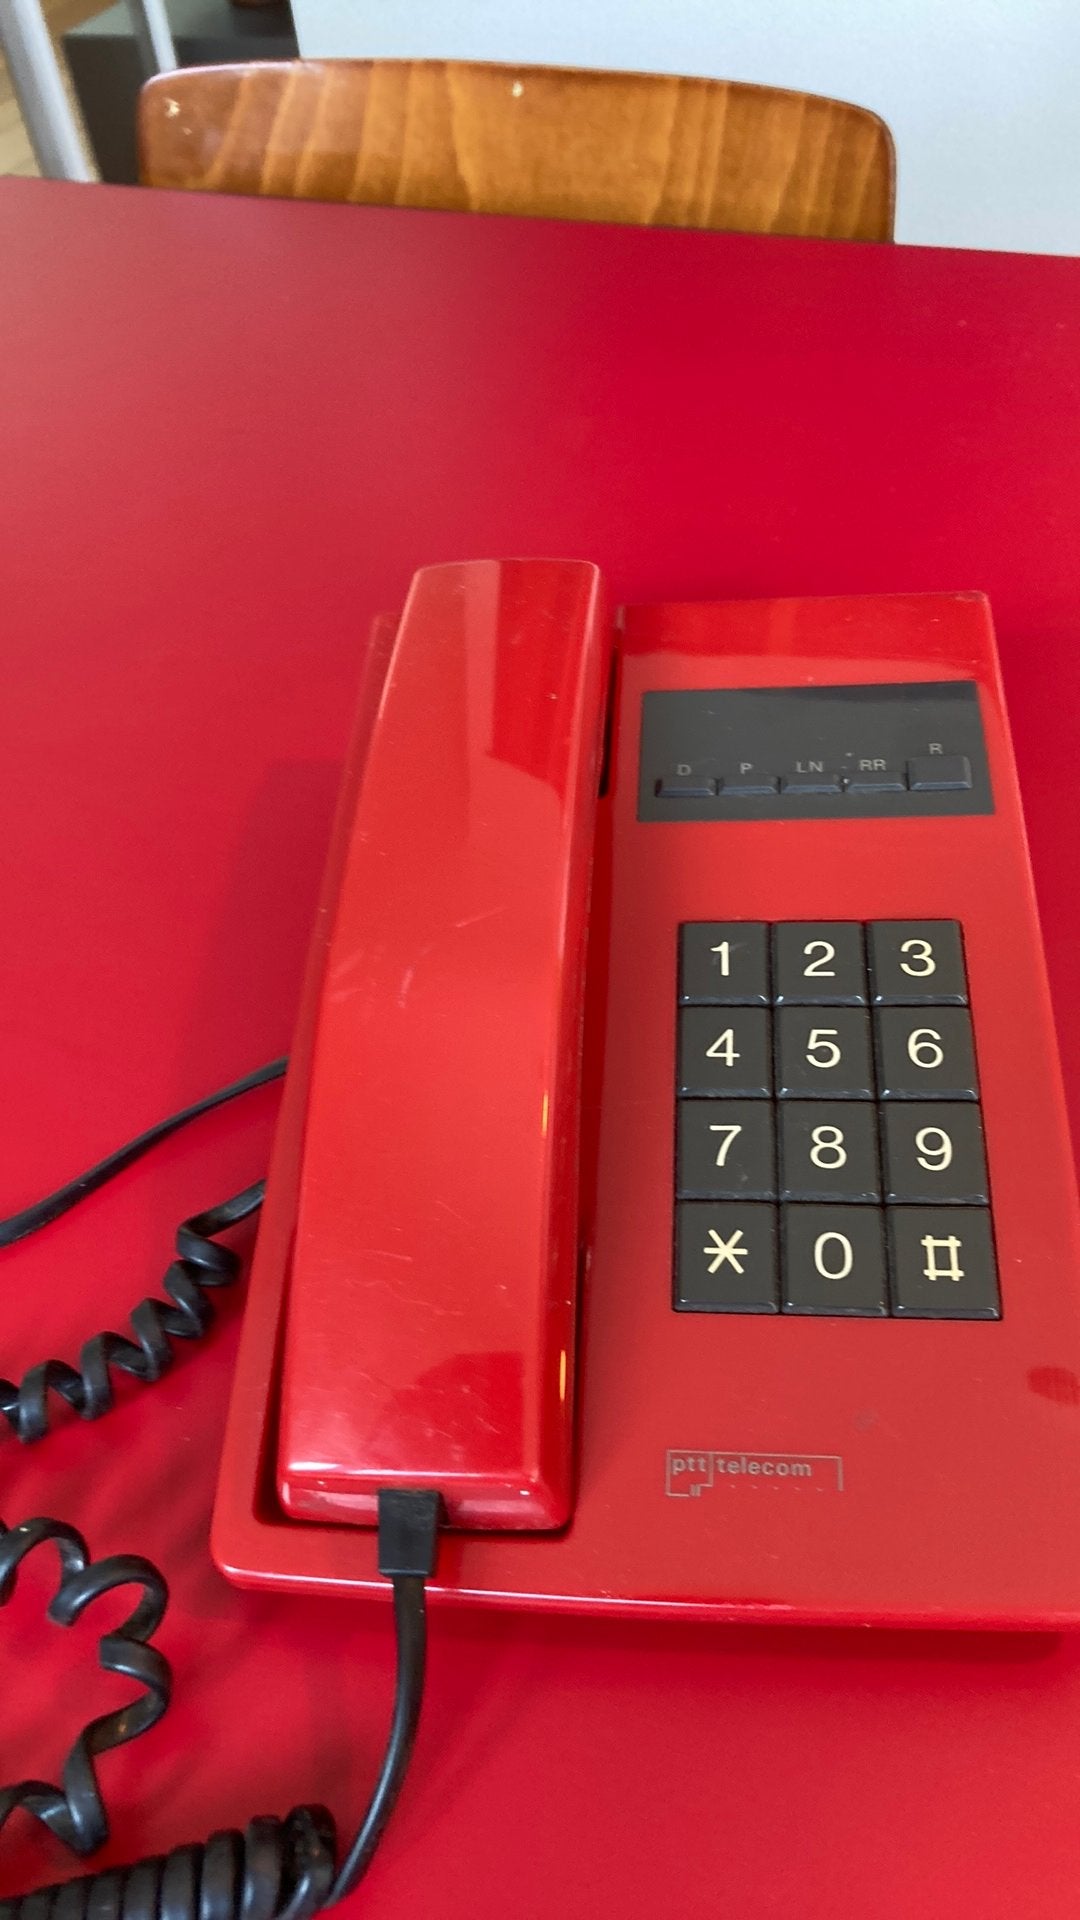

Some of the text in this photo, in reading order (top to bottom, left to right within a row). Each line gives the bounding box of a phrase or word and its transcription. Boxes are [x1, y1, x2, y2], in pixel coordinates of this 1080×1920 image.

[677, 742, 943, 777] D P LN RR R
[710, 939, 936, 977] 1 2 3
[705, 1028, 944, 1069] 4 5 6
[708, 1124, 953, 1172] 7 8 9
[814, 1231, 854, 1280] 0
[920, 1234, 965, 1282] #
[672, 1456, 812, 1477] ptt telecom
